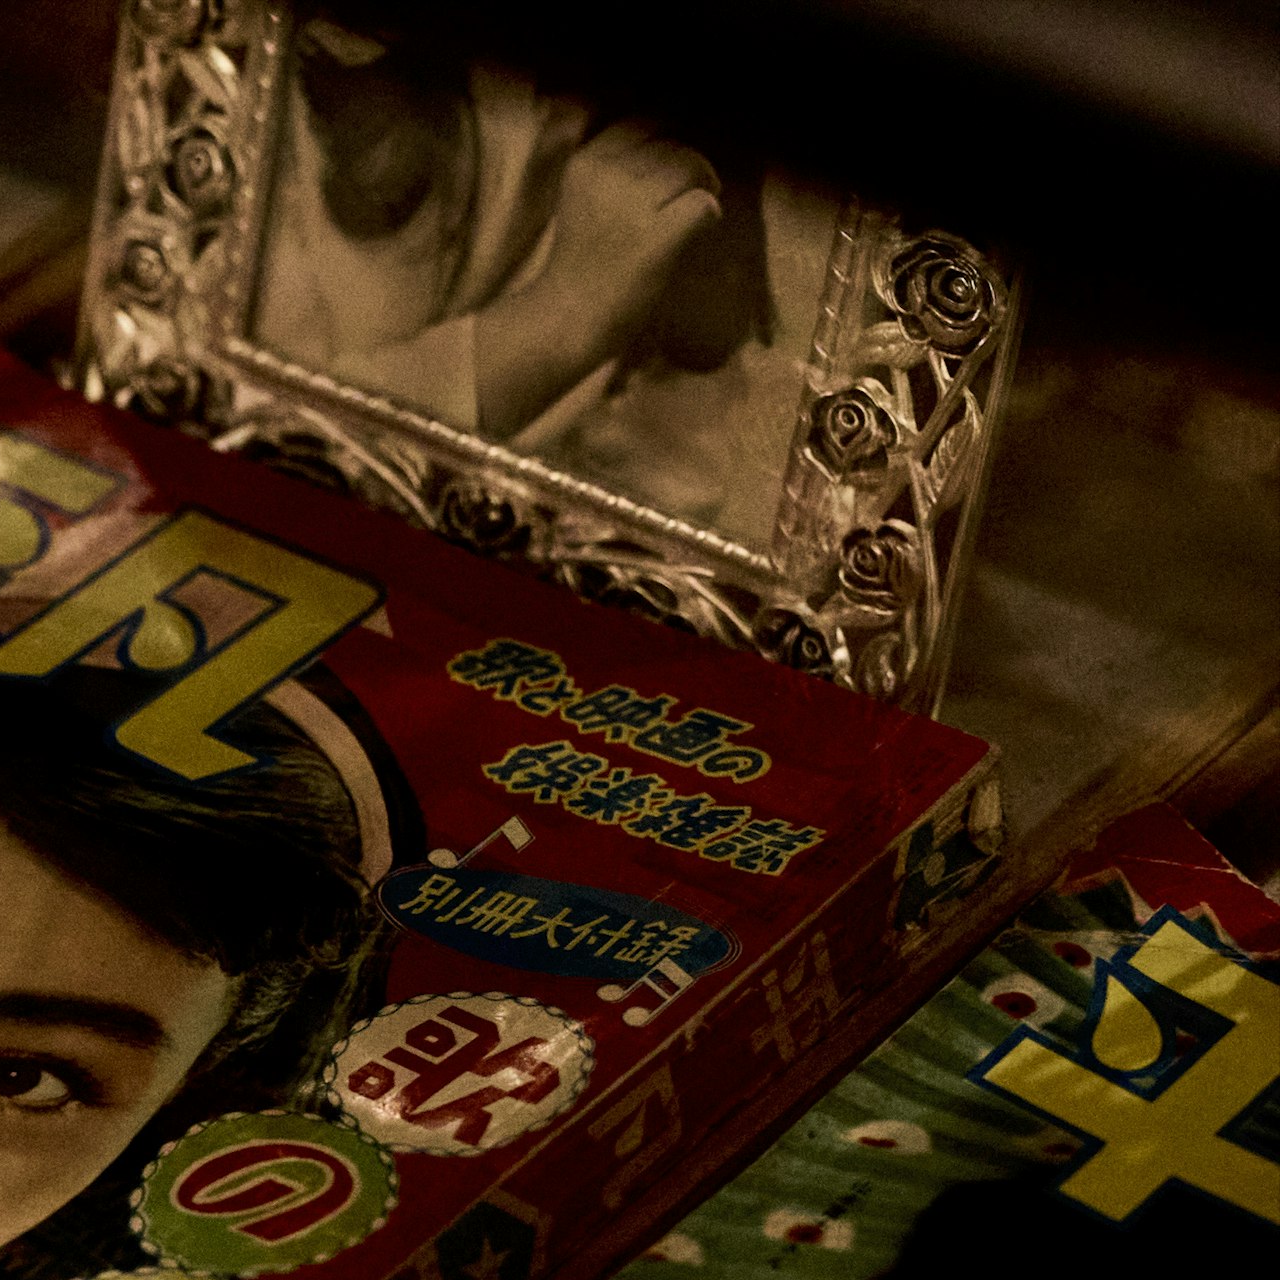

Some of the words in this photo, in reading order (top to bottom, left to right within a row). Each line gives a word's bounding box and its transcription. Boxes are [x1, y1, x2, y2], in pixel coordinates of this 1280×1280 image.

[447, 637, 772, 784] 歌と映画の
[482, 740, 827, 877] 娯楽雑誌
[397, 873, 700, 968] 別冊大付録
